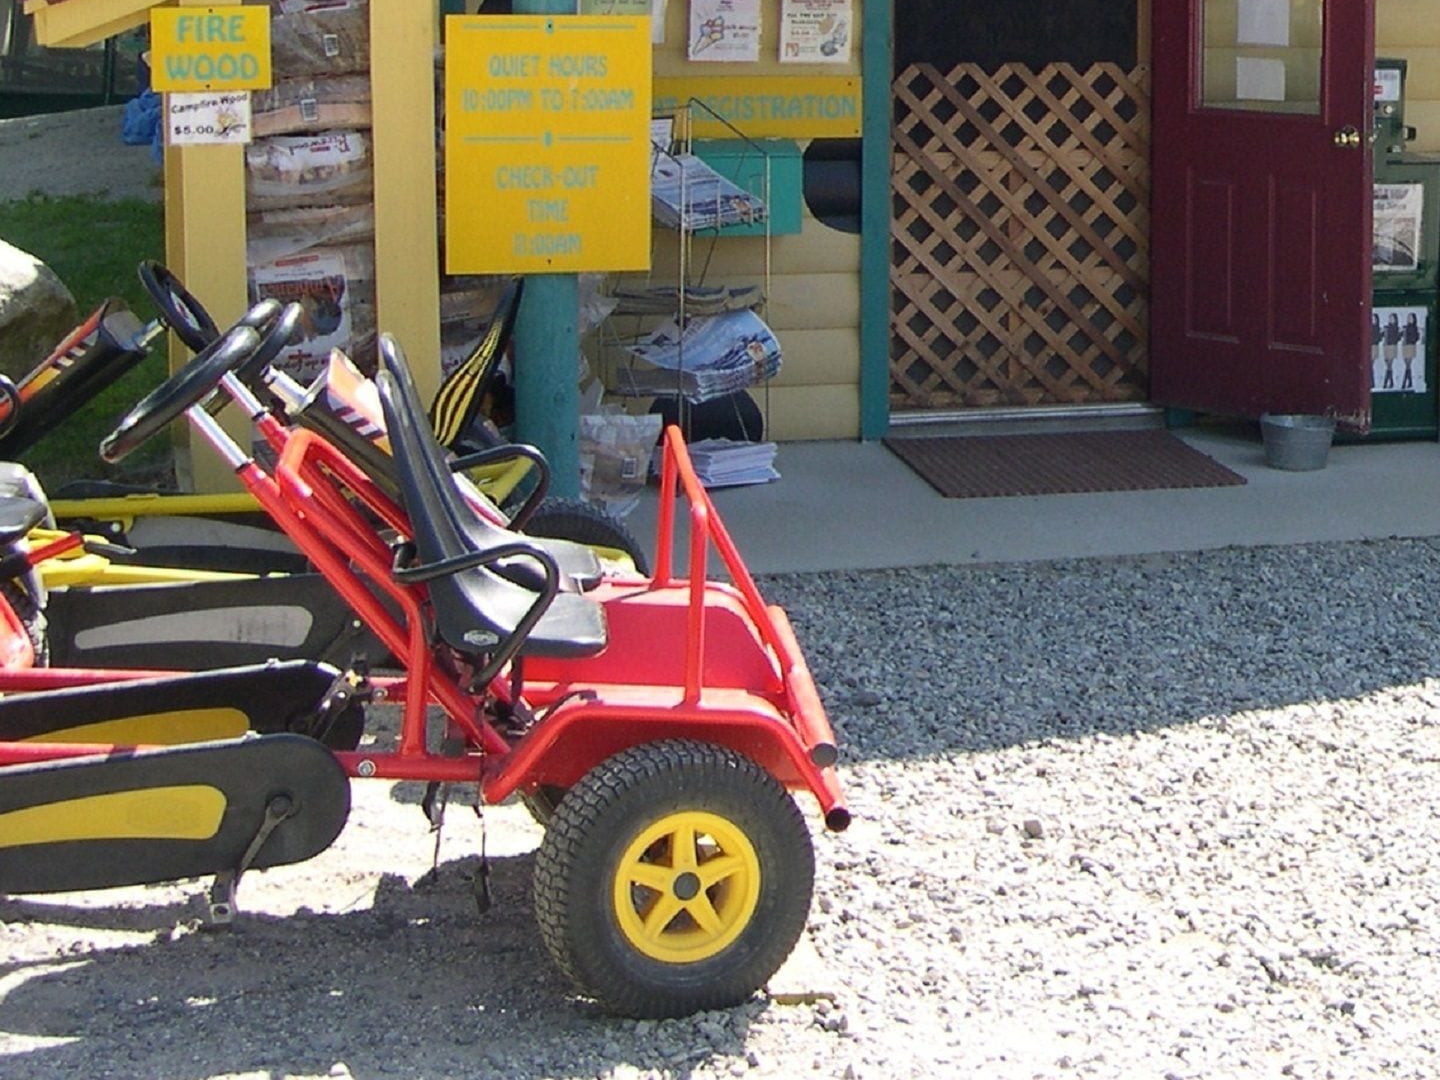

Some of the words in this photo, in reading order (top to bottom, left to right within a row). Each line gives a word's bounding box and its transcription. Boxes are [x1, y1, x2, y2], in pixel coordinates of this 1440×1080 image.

[176, 14, 246, 43] FIRE
[165, 53, 259, 81] WOOD
[489, 55, 540, 78] QUIET
[547, 55, 608, 78] HOURS
[171, 99, 219, 114] Campfire
[220, 92, 247, 104] Wood
[539, 88, 563, 112] TO
[174, 125, 214, 135] $5.00
[495, 164, 599, 190] CHECK-OUT
[526, 198, 570, 223] TIME
